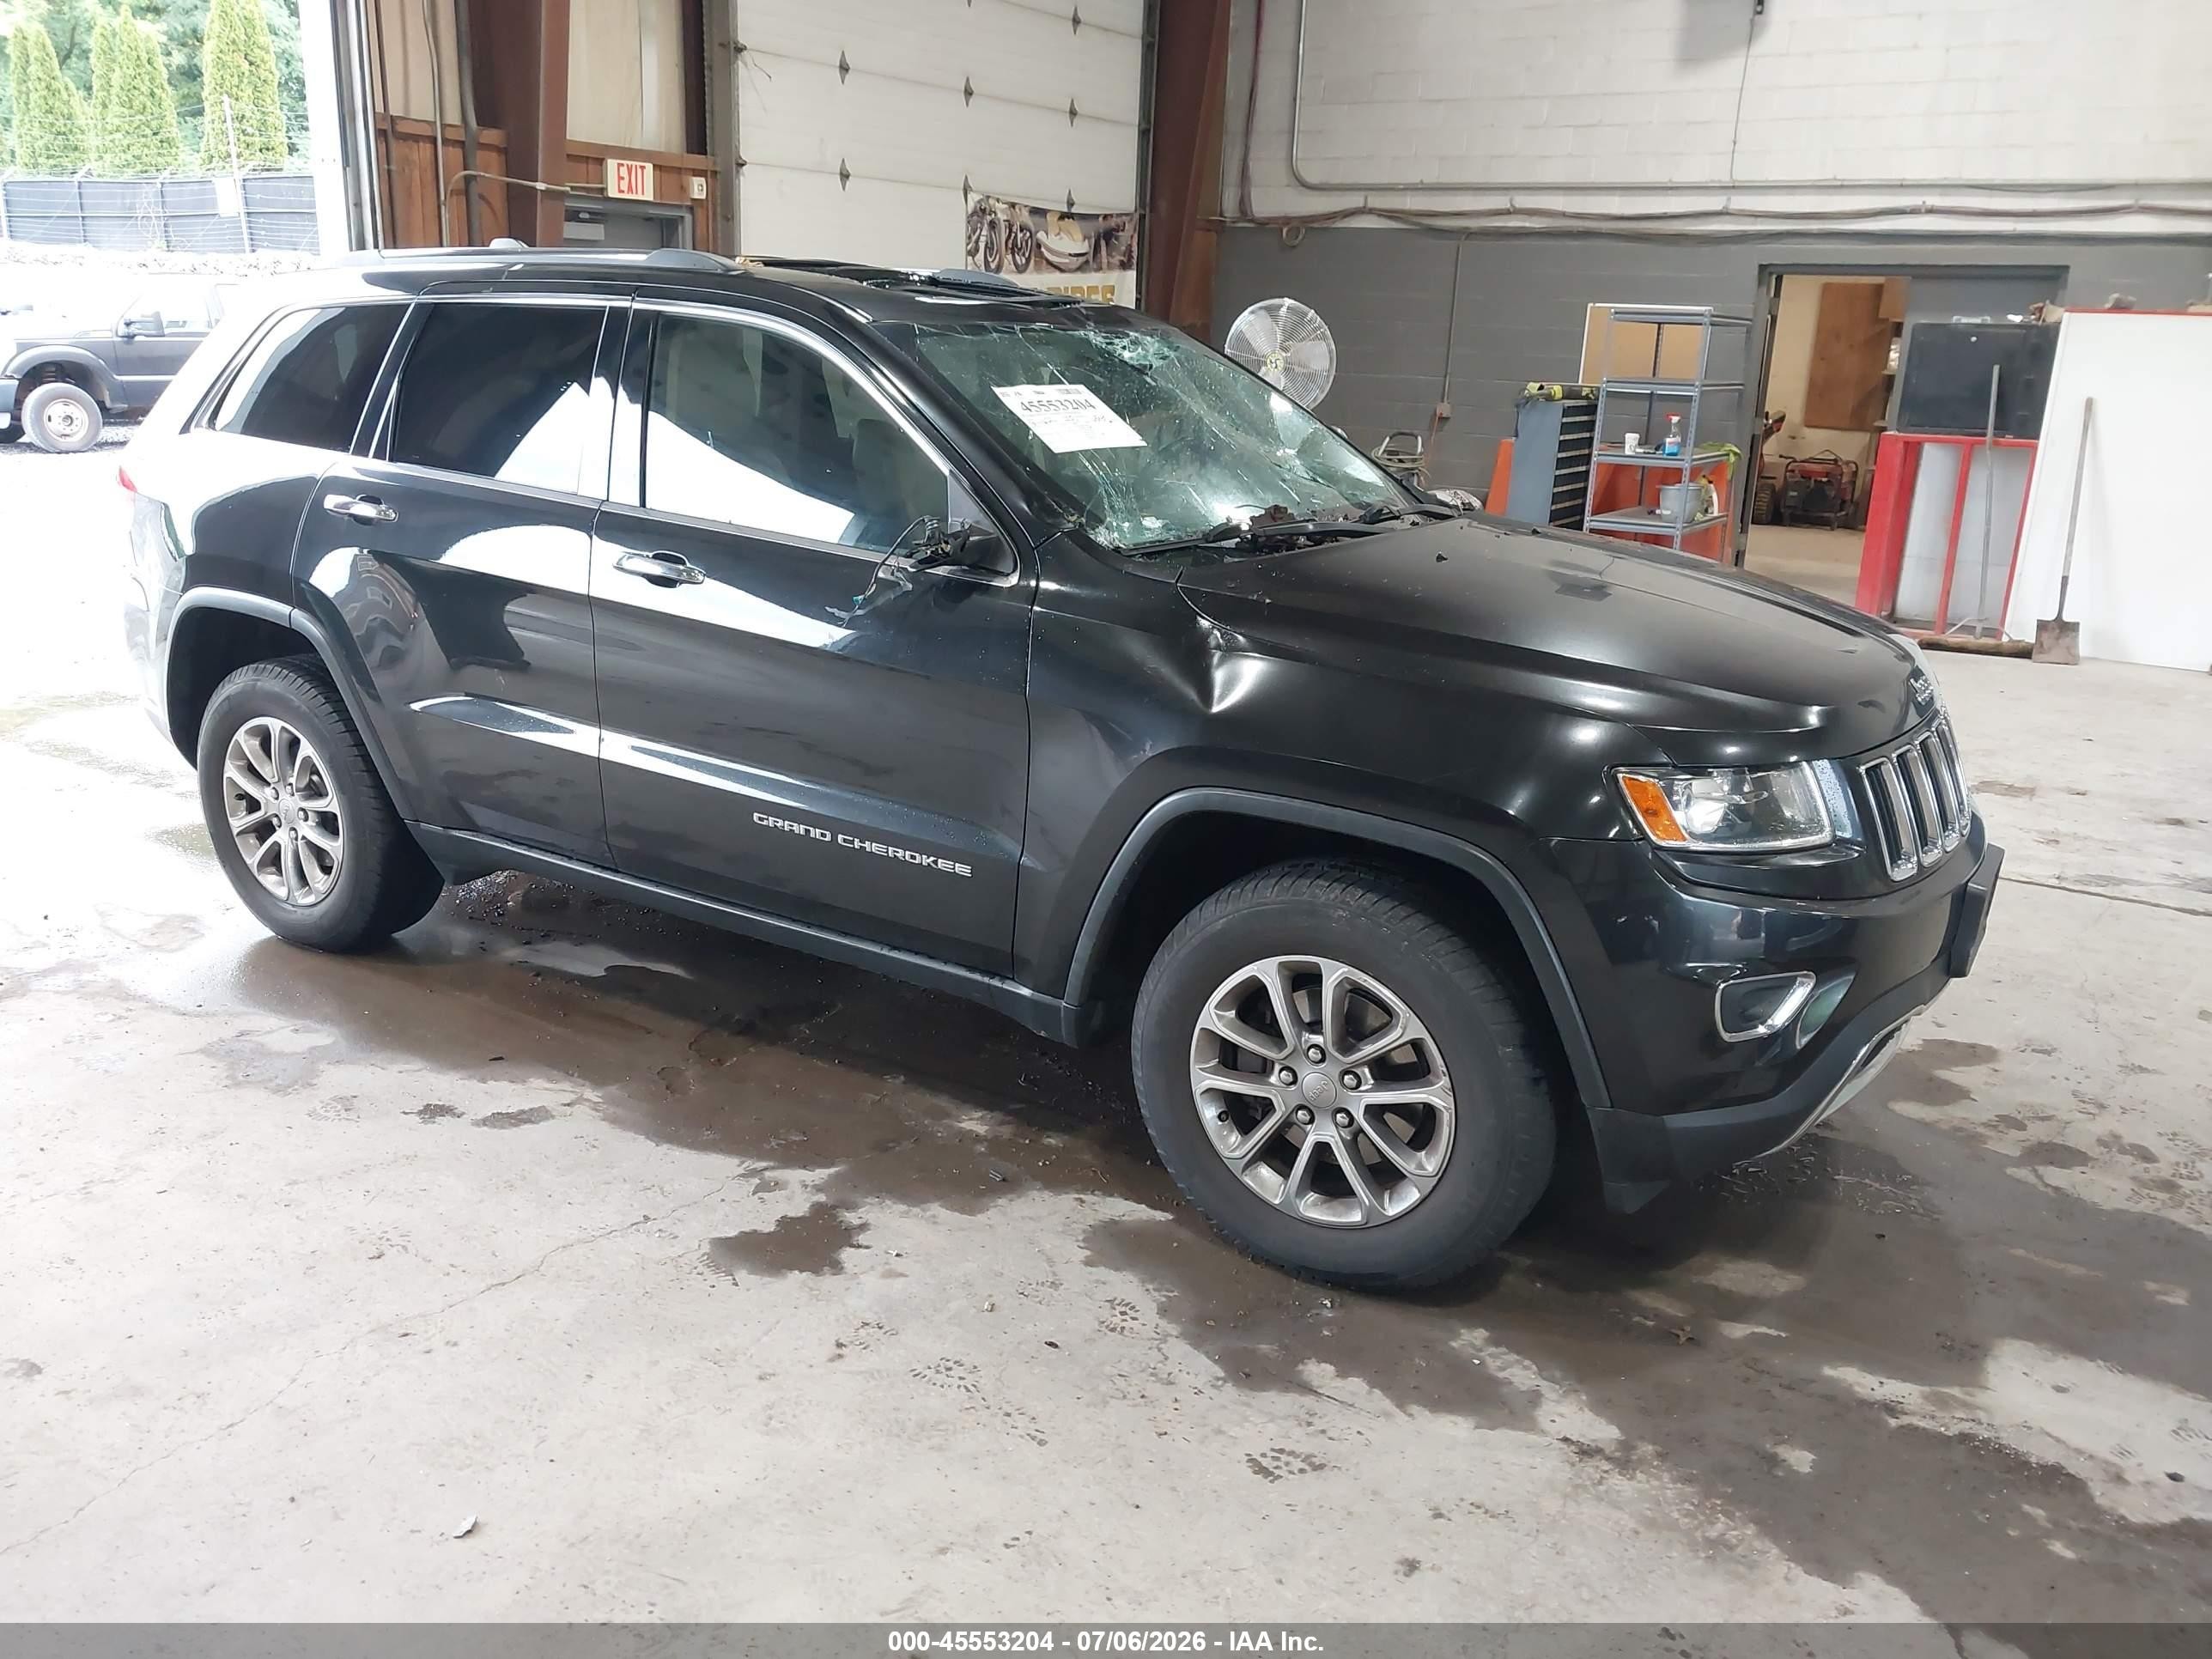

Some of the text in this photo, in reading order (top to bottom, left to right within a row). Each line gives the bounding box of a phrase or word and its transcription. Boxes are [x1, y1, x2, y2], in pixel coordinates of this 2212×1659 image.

[617, 162, 646, 196] EXIT
[1020, 398, 1097, 413] 45553204
[753, 812, 973, 878] GRAND CHEROKEE
